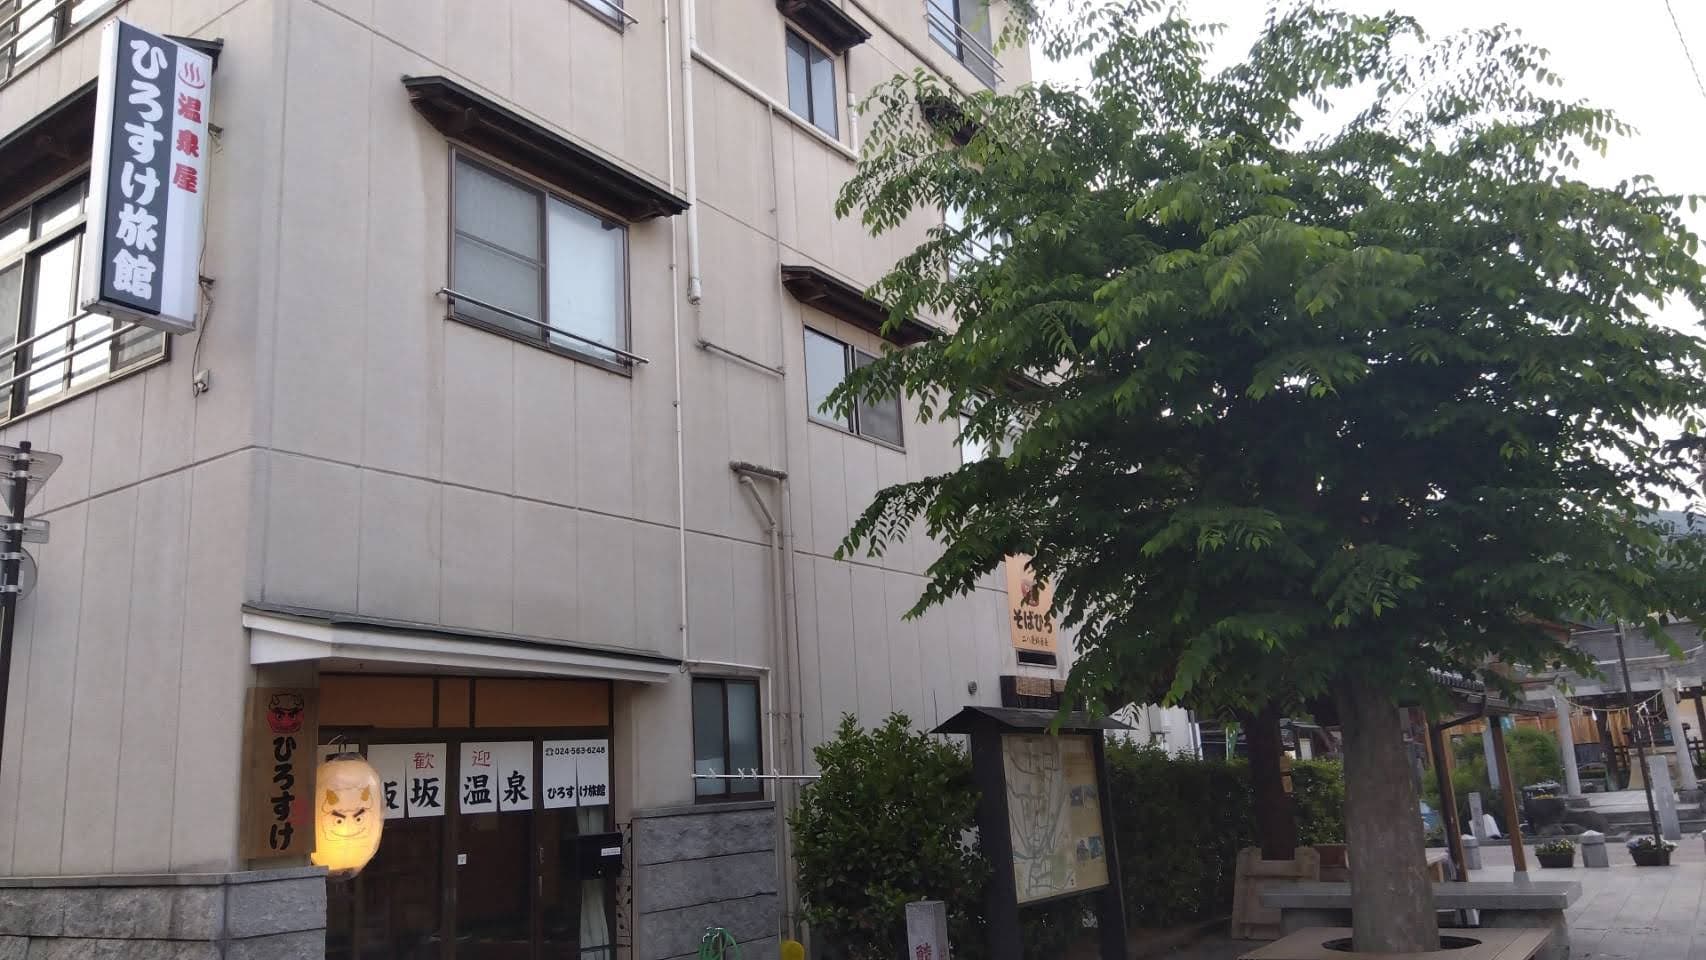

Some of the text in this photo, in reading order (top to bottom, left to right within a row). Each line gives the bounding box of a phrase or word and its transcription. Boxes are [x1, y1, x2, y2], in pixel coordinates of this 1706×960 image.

[113, 39, 168, 300] ひろすけ旅館
[172, 93, 203, 194] 温泉屋
[1013, 608, 1053, 634] そばひろ
[269, 736, 297, 850] ひろすけ
[547, 784, 606, 799] ひろすけ旅館
